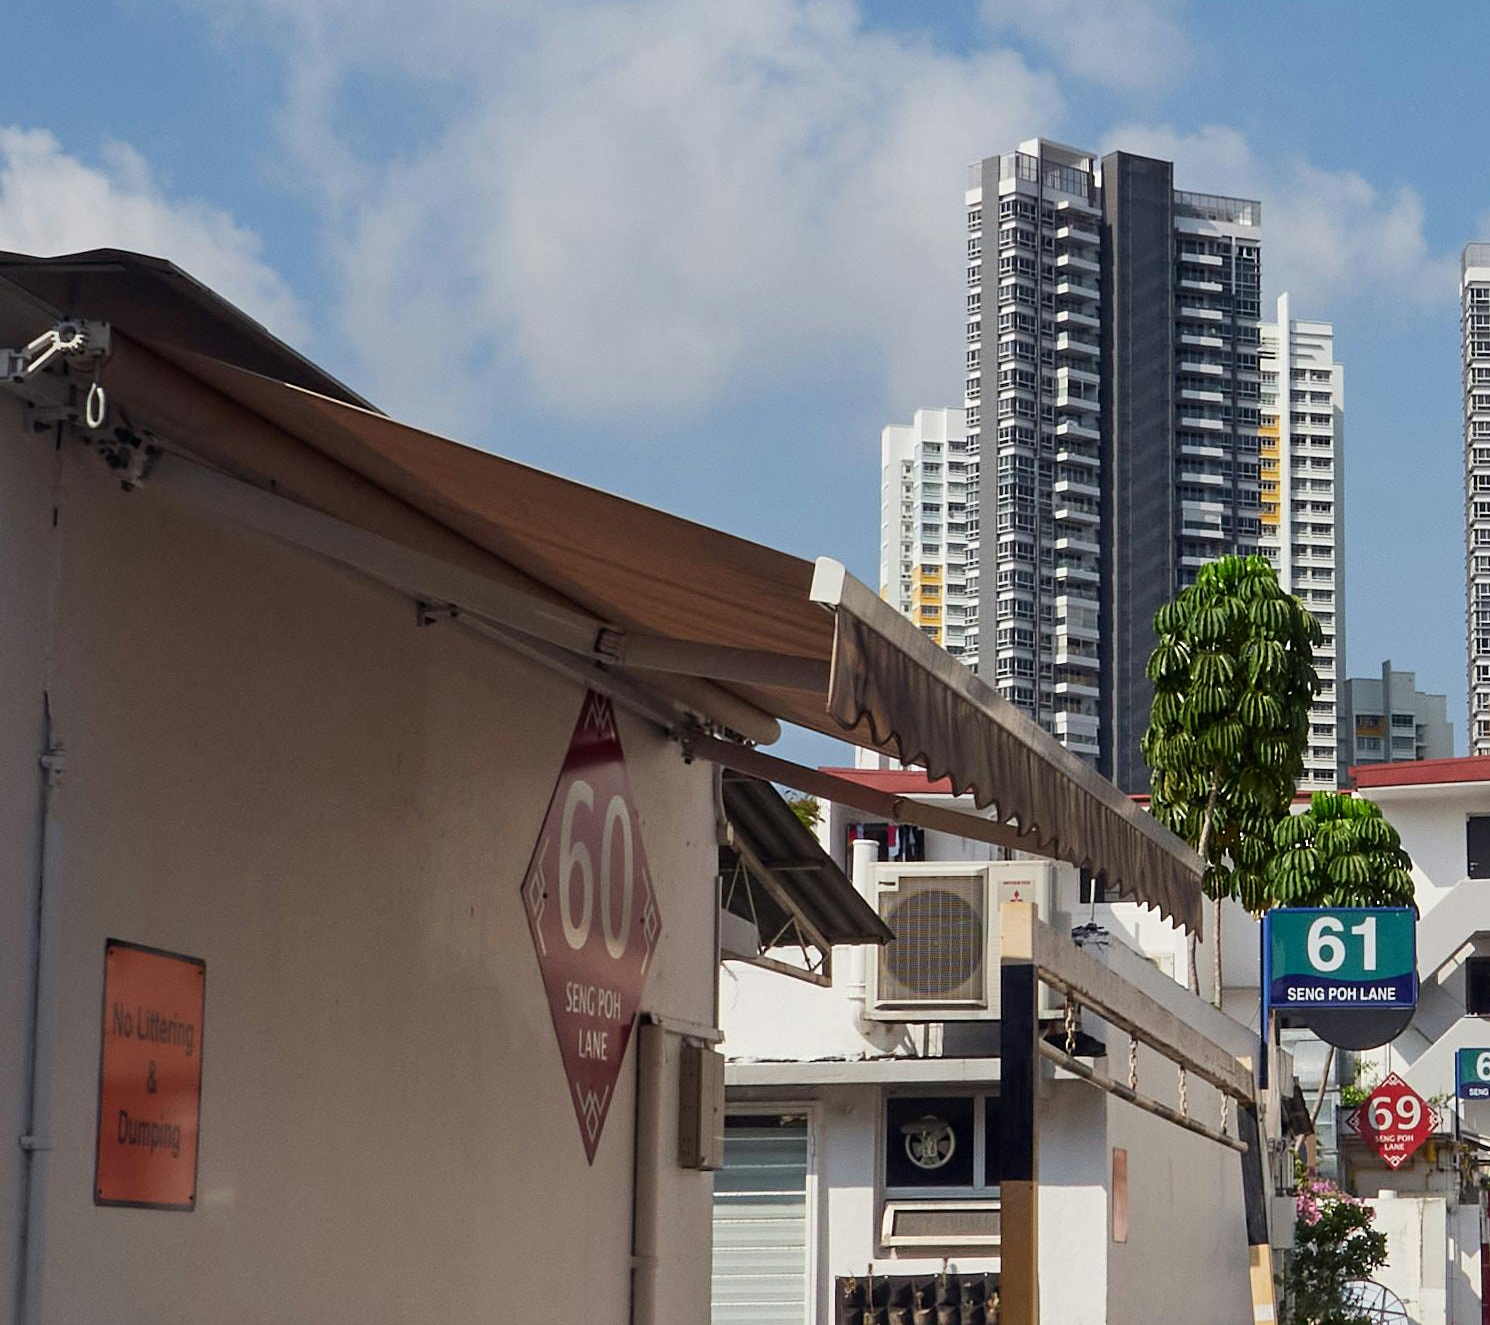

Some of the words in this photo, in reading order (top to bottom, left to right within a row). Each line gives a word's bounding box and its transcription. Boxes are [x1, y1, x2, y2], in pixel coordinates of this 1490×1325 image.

[559, 779, 633, 960] 60
[1307, 916, 1377, 972] 61
[566, 981, 595, 1016] SENG
[599, 985, 621, 1020] POH
[1287, 987, 1325, 1001] SENG
[1328, 987, 1357, 1001] POH
[1360, 987, 1396, 1001] LANE
[112, 1002, 133, 1037] No
[137, 1006, 194, 1056] Littering
[578, 1029, 607, 1061] LANE
[146, 1059, 158, 1093] &
[1469, 1088, 1489, 1096] SENG
[1368, 1095, 1421, 1131] 69
[117, 1110, 181, 1158] Dumping
[1384, 1143, 1405, 1151] LANE
